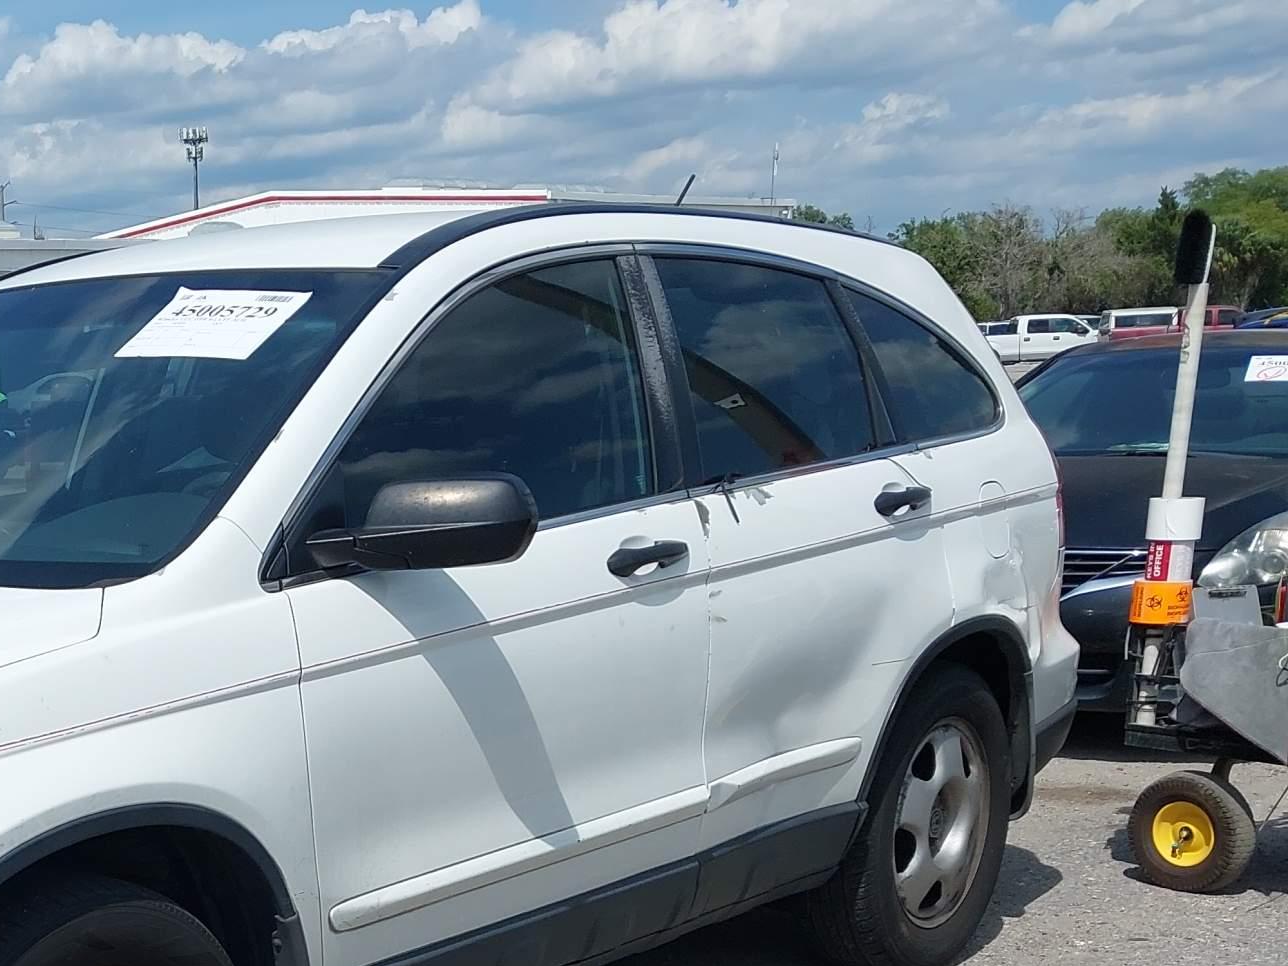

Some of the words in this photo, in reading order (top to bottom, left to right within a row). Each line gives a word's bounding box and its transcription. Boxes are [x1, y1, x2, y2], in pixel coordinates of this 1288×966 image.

[171, 304, 279, 318] 45005729
[1146, 554, 1154, 579] KEYS
[1153, 544, 1164, 577] OFFICE
